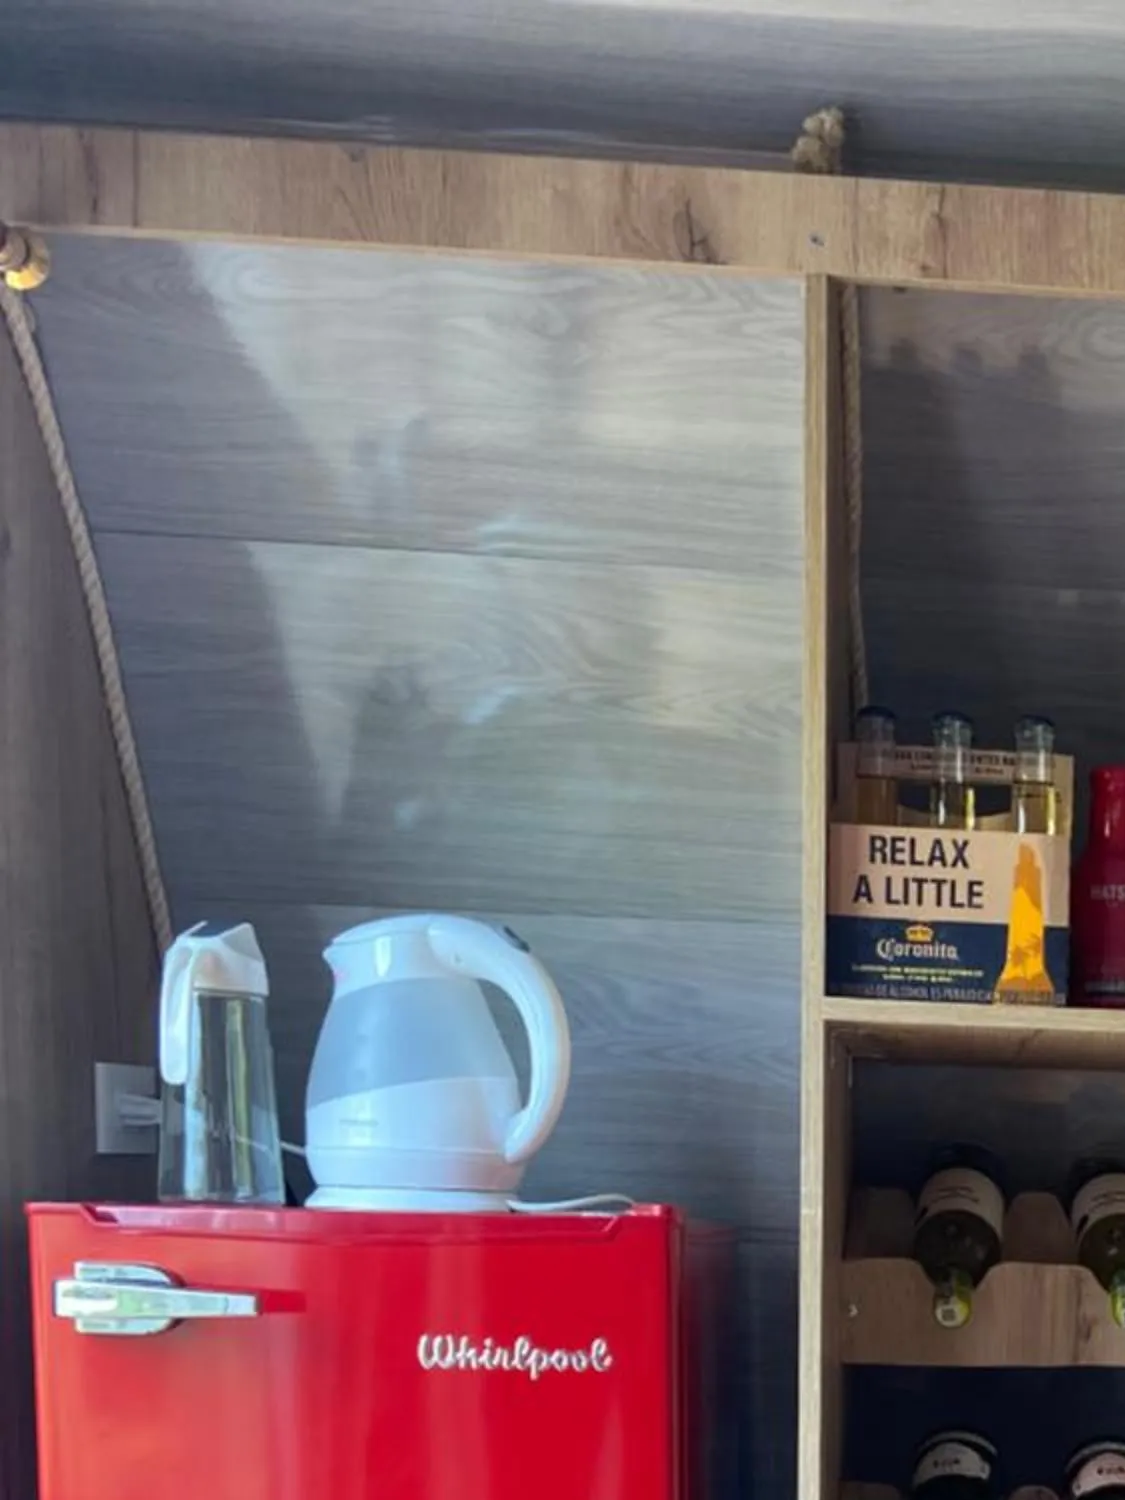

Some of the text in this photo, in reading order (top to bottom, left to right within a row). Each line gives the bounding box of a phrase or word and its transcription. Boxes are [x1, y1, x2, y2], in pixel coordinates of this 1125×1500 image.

[868, 835, 969, 868] RELAX
[853, 875, 983, 909] A LITTLE
[876, 938, 959, 961] Coronita
[417, 1333, 613, 1381] Whirlpool
